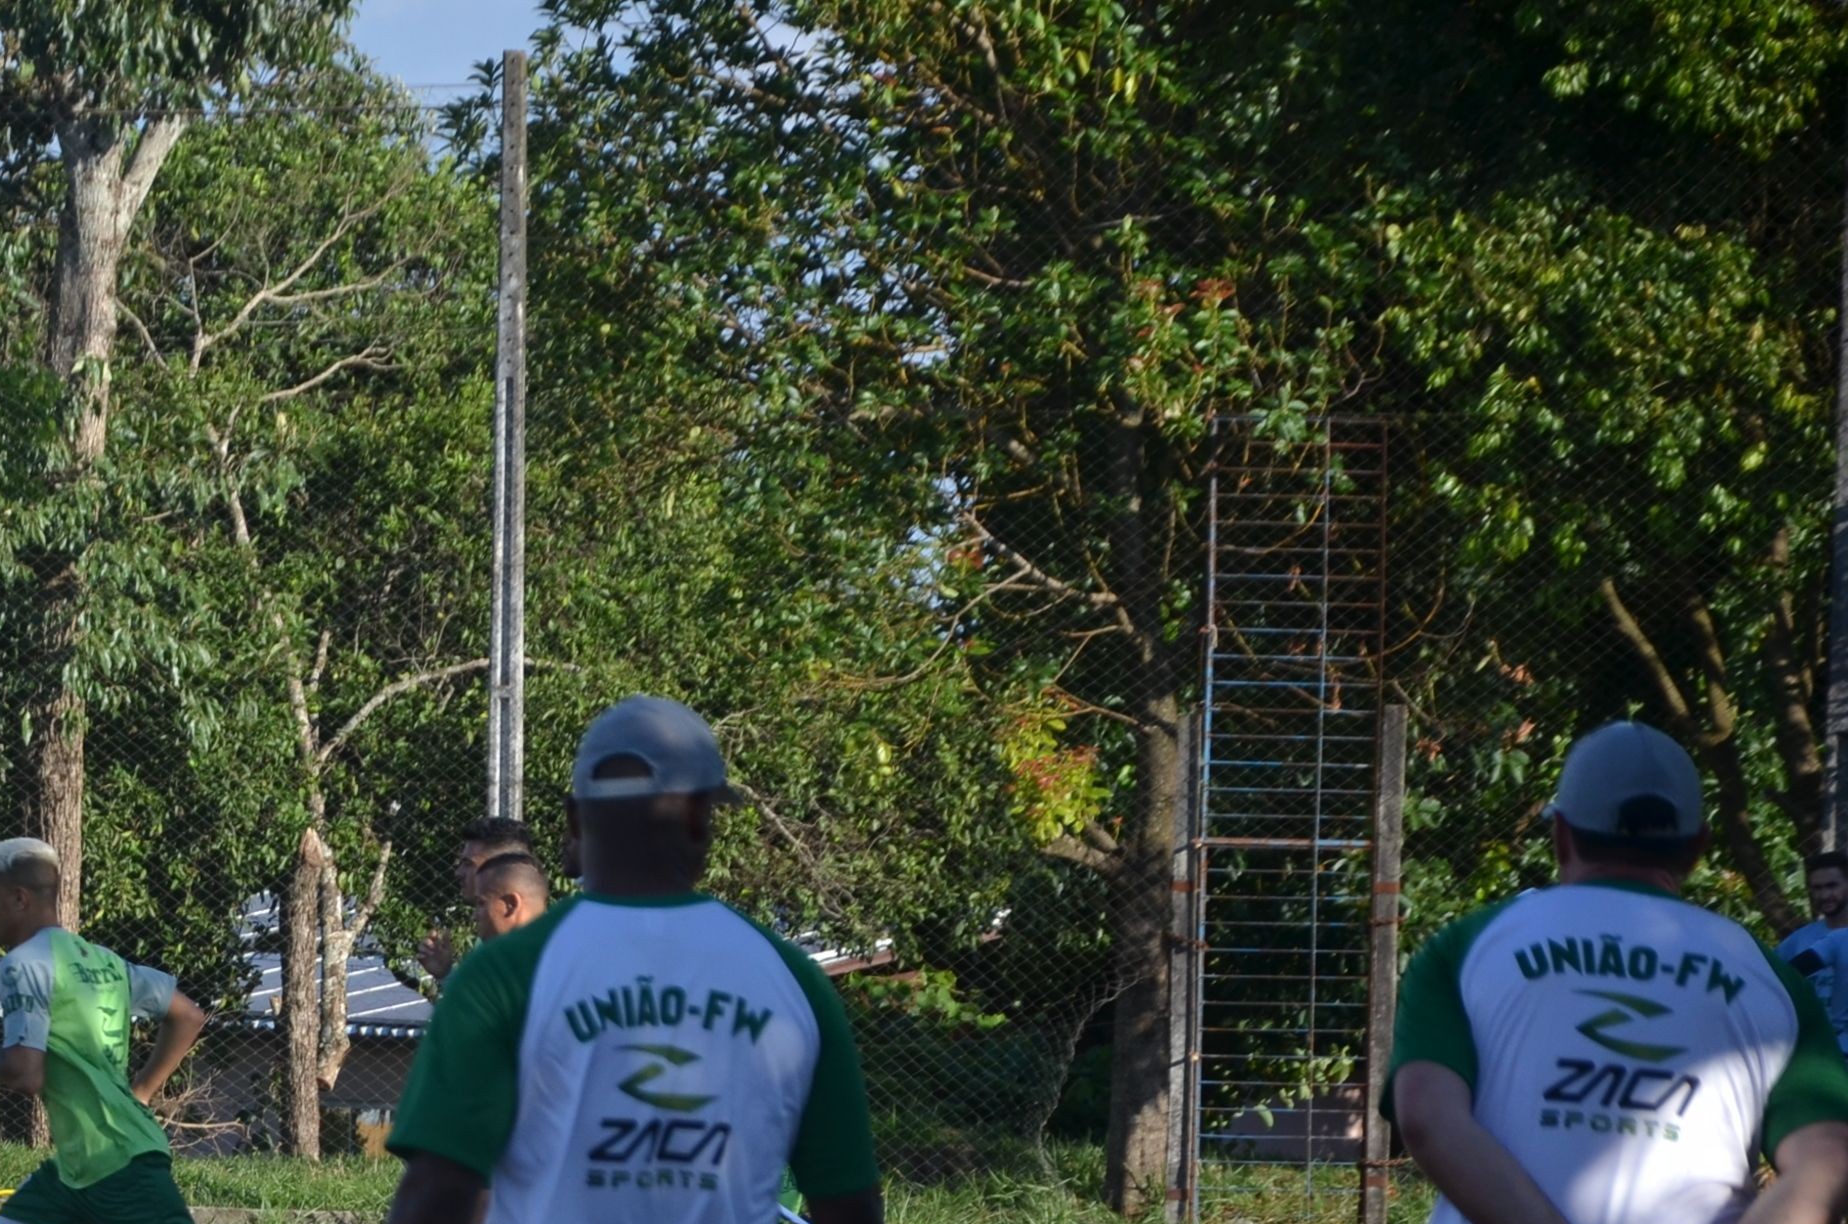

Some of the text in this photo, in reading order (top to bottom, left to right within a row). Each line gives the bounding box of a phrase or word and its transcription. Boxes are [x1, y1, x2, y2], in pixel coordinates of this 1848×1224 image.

[1513, 934, 1746, 1006] UNIÃO-FW
[563, 975, 774, 1046] UNIÃO-FW
[1542, 1058, 1701, 1117] ZACA
[587, 1117, 732, 1167] ZACA
[1539, 1109, 1681, 1142] SPORTS
[585, 1169, 720, 1191] SPORTS
